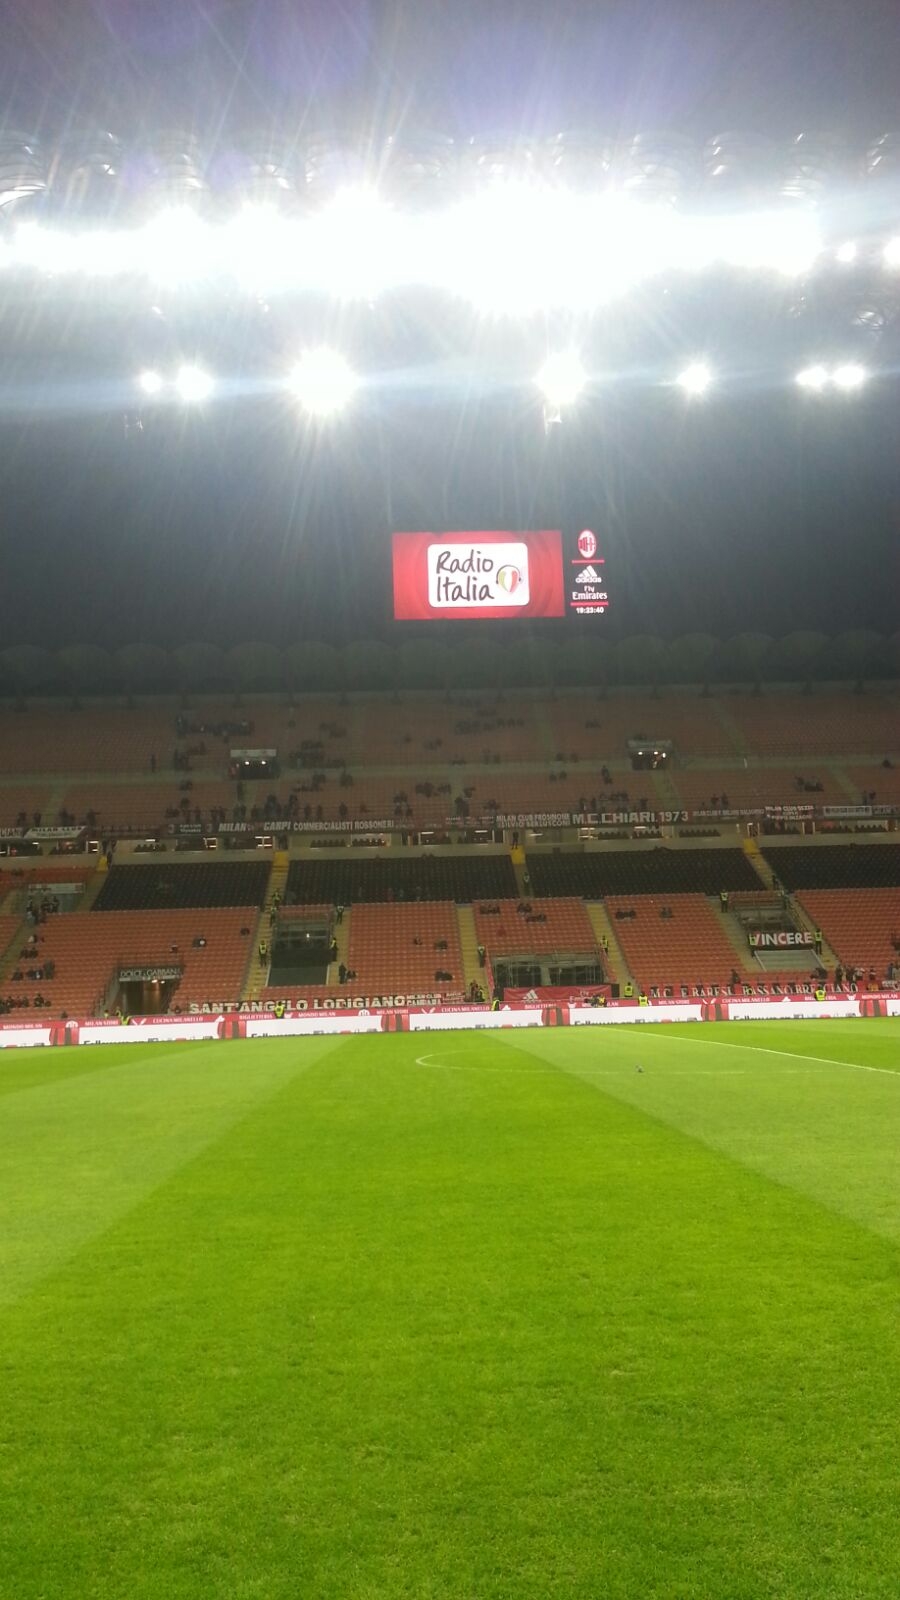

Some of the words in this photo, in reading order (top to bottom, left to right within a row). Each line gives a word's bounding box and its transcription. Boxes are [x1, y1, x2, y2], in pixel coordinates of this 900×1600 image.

[436, 549, 494, 574] Radio
[436, 575, 496, 602] Italia
[572, 591, 608, 600] Emirates
